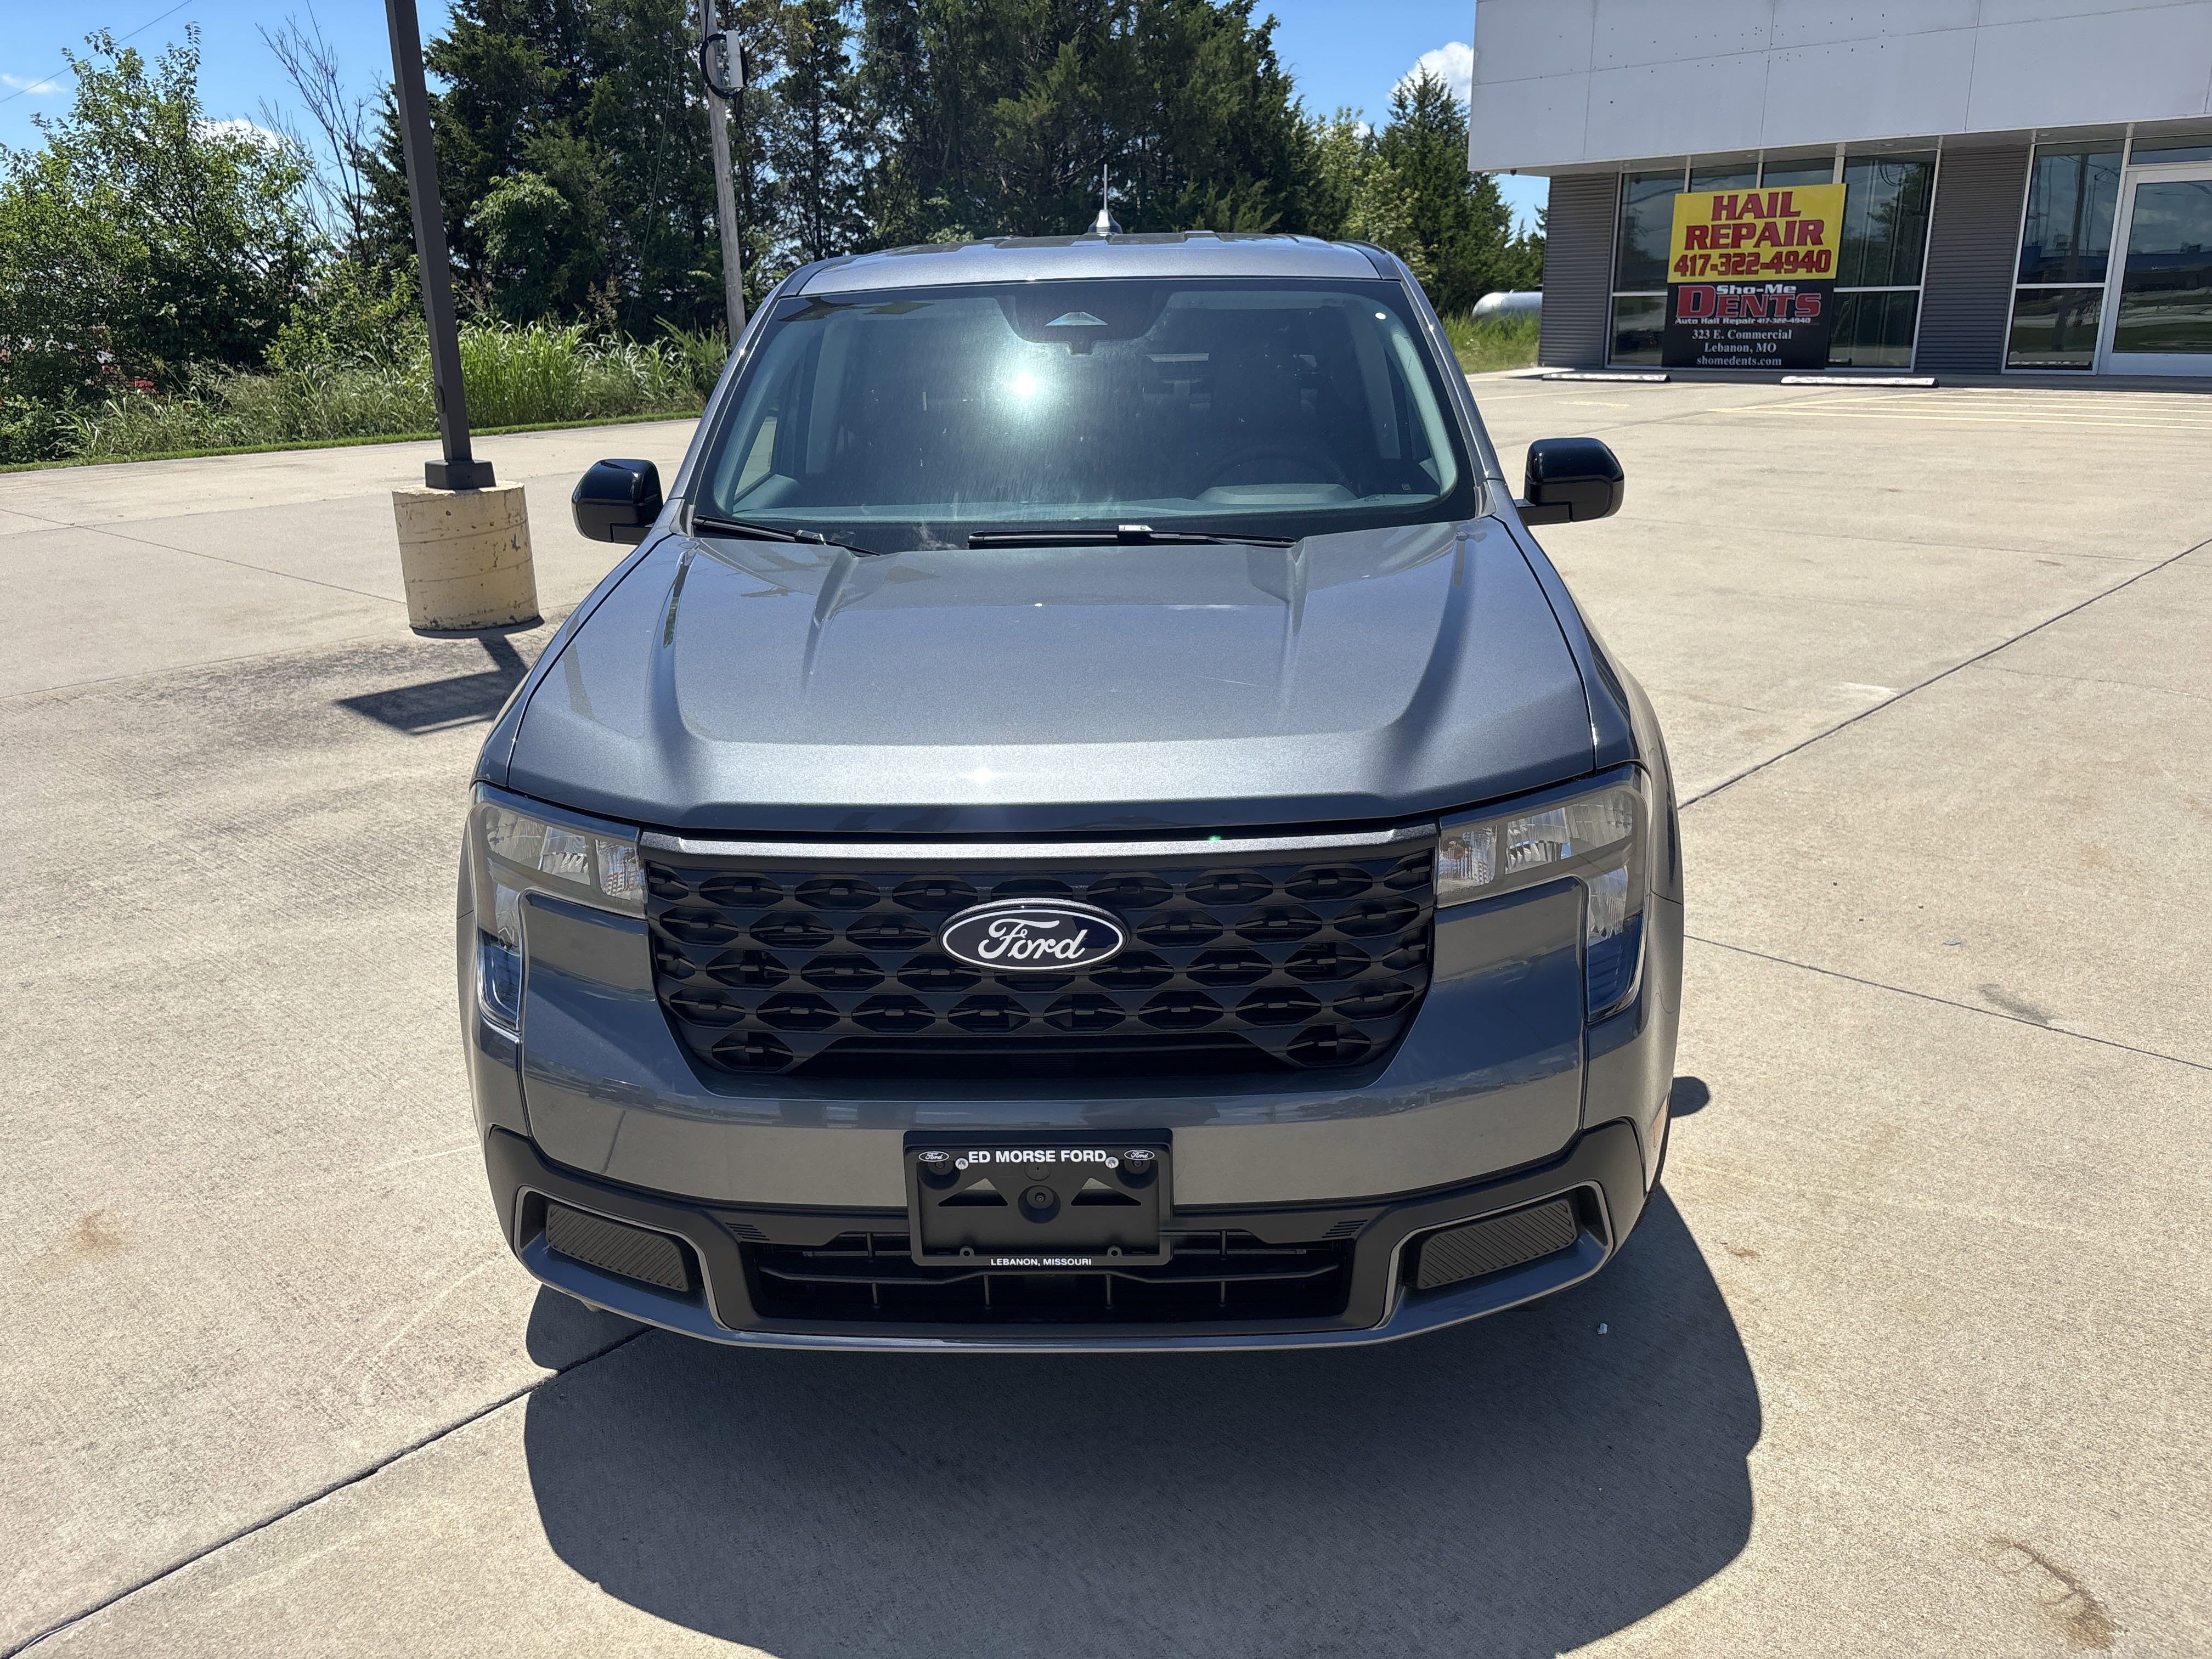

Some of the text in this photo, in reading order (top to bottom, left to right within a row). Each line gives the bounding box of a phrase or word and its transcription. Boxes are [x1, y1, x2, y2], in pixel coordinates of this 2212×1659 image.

[1711, 191, 1801, 221] HAIL
[1684, 219, 1825, 251] REPAIR
[1674, 249, 1831, 276] 417-322-4940
[1716, 284, 1797, 295] Sho-Me
[1675, 285, 1821, 318] DENTS
[1723, 317, 1756, 326] Repair
[1691, 329, 1792, 340] 323 E. Commercial
[1704, 342, 1777, 353] Lebanon, MO
[1696, 356, 1782, 366] shomedents.com
[978, 918, 1088, 959] Ford
[968, 1150, 1107, 1163] ED MORSE FORD
[991, 1257, 1092, 1267] LEBANON, MISSOURI
